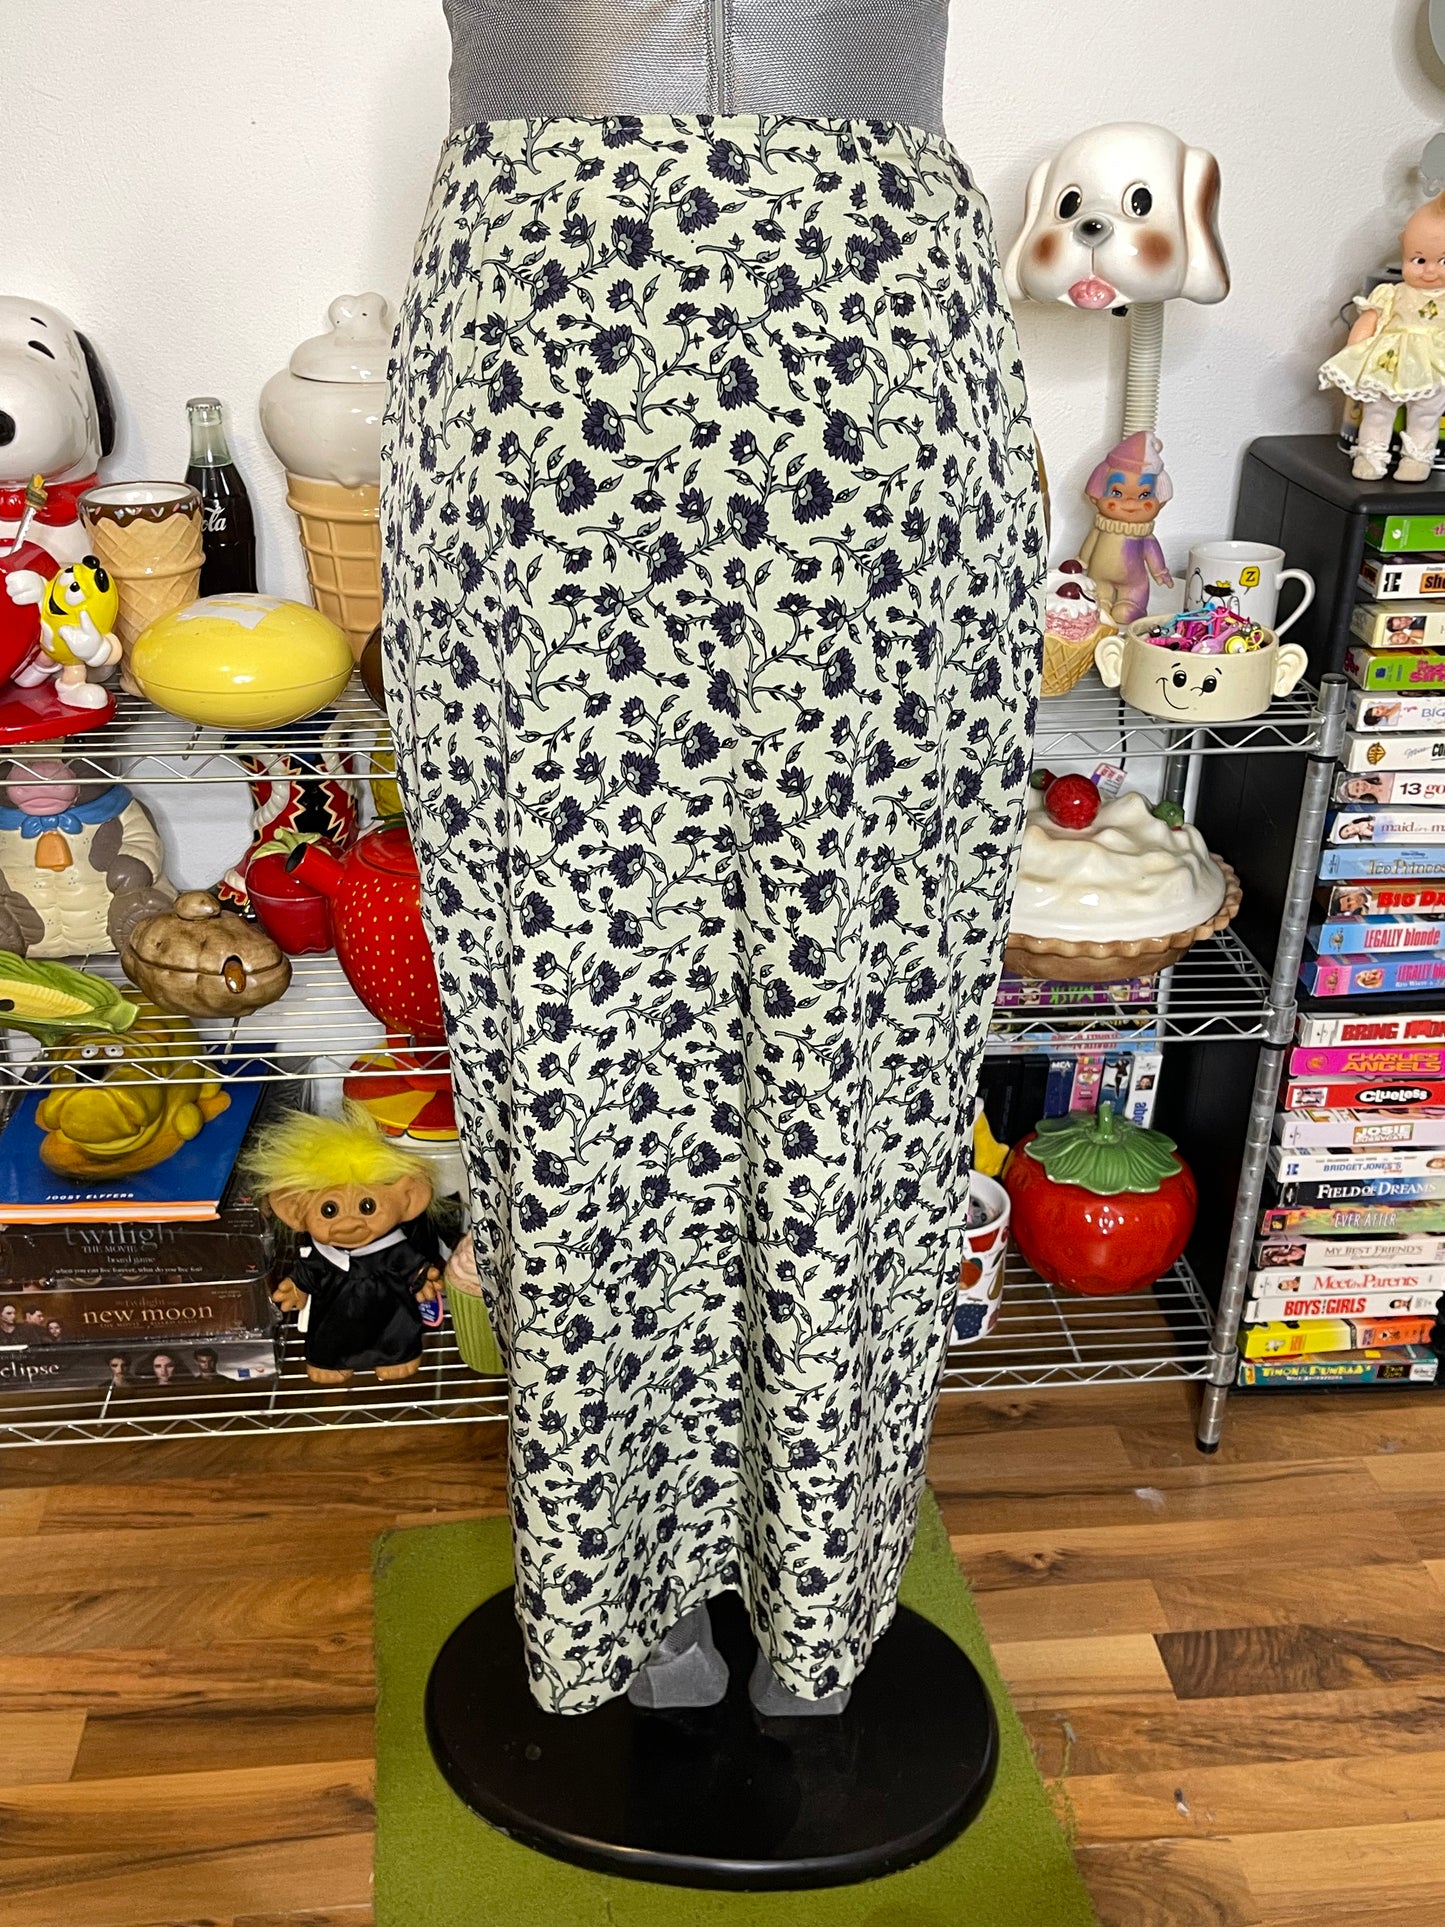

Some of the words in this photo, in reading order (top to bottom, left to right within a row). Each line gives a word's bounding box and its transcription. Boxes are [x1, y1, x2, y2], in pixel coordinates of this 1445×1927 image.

[201, 506, 228, 533] ola
[1245, 571, 1256, 583] Z
[1432, 743, 1445, 757] CO
[1400, 783, 1422, 796] 13
[1381, 821, 1415, 832] maid
[1366, 859, 1392, 875] Ice
[1363, 929, 1404, 949] LEGALLY
[1403, 927, 1441, 947] blonde
[1340, 1022, 1400, 1042] BRING
[1051, 1061, 1071, 1069] MCA
[1341, 1061, 1442, 1073] ANGELS
[1133, 1102, 1147, 1126] abo
[1359, 1125, 1412, 1136] JOSIE
[1323, 1162, 1363, 1172] BRIDGET
[1316, 1183, 1361, 1199] FIELD
[1361, 1184, 1377, 1197] OF
[1377, 1181, 1436, 1196] DREAMS
[1334, 1213, 1361, 1228] EVER
[1364, 1212, 1397, 1227] AFTER
[1325, 1246, 1342, 1255] MY
[1344, 1246, 1371, 1254] BEST
[1373, 1244, 1423, 1254] FRIEND'S
[1362, 1273, 1419, 1288] Parents
[83, 1309, 134, 1324] new
[141, 1305, 213, 1321] moon
[1283, 1299, 1322, 1316] BOYS
[1326, 1298, 1367, 1314] GIRLS
